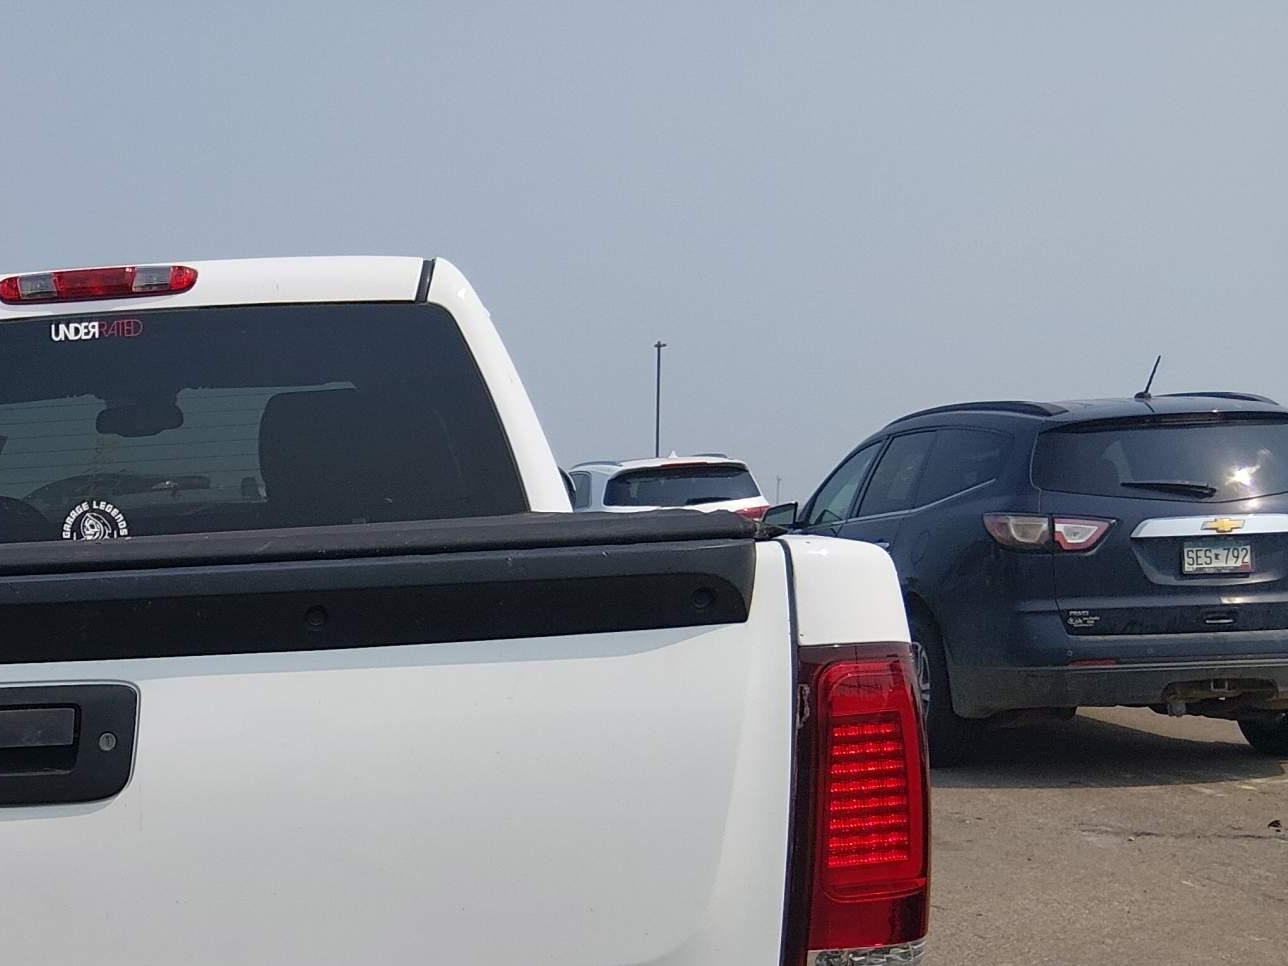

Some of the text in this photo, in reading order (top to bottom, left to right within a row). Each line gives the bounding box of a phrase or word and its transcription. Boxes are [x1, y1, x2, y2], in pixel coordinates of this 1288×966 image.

[62, 500, 128, 539] GARAGE LEGENDS
[1186, 547, 1249, 566] SES 792
